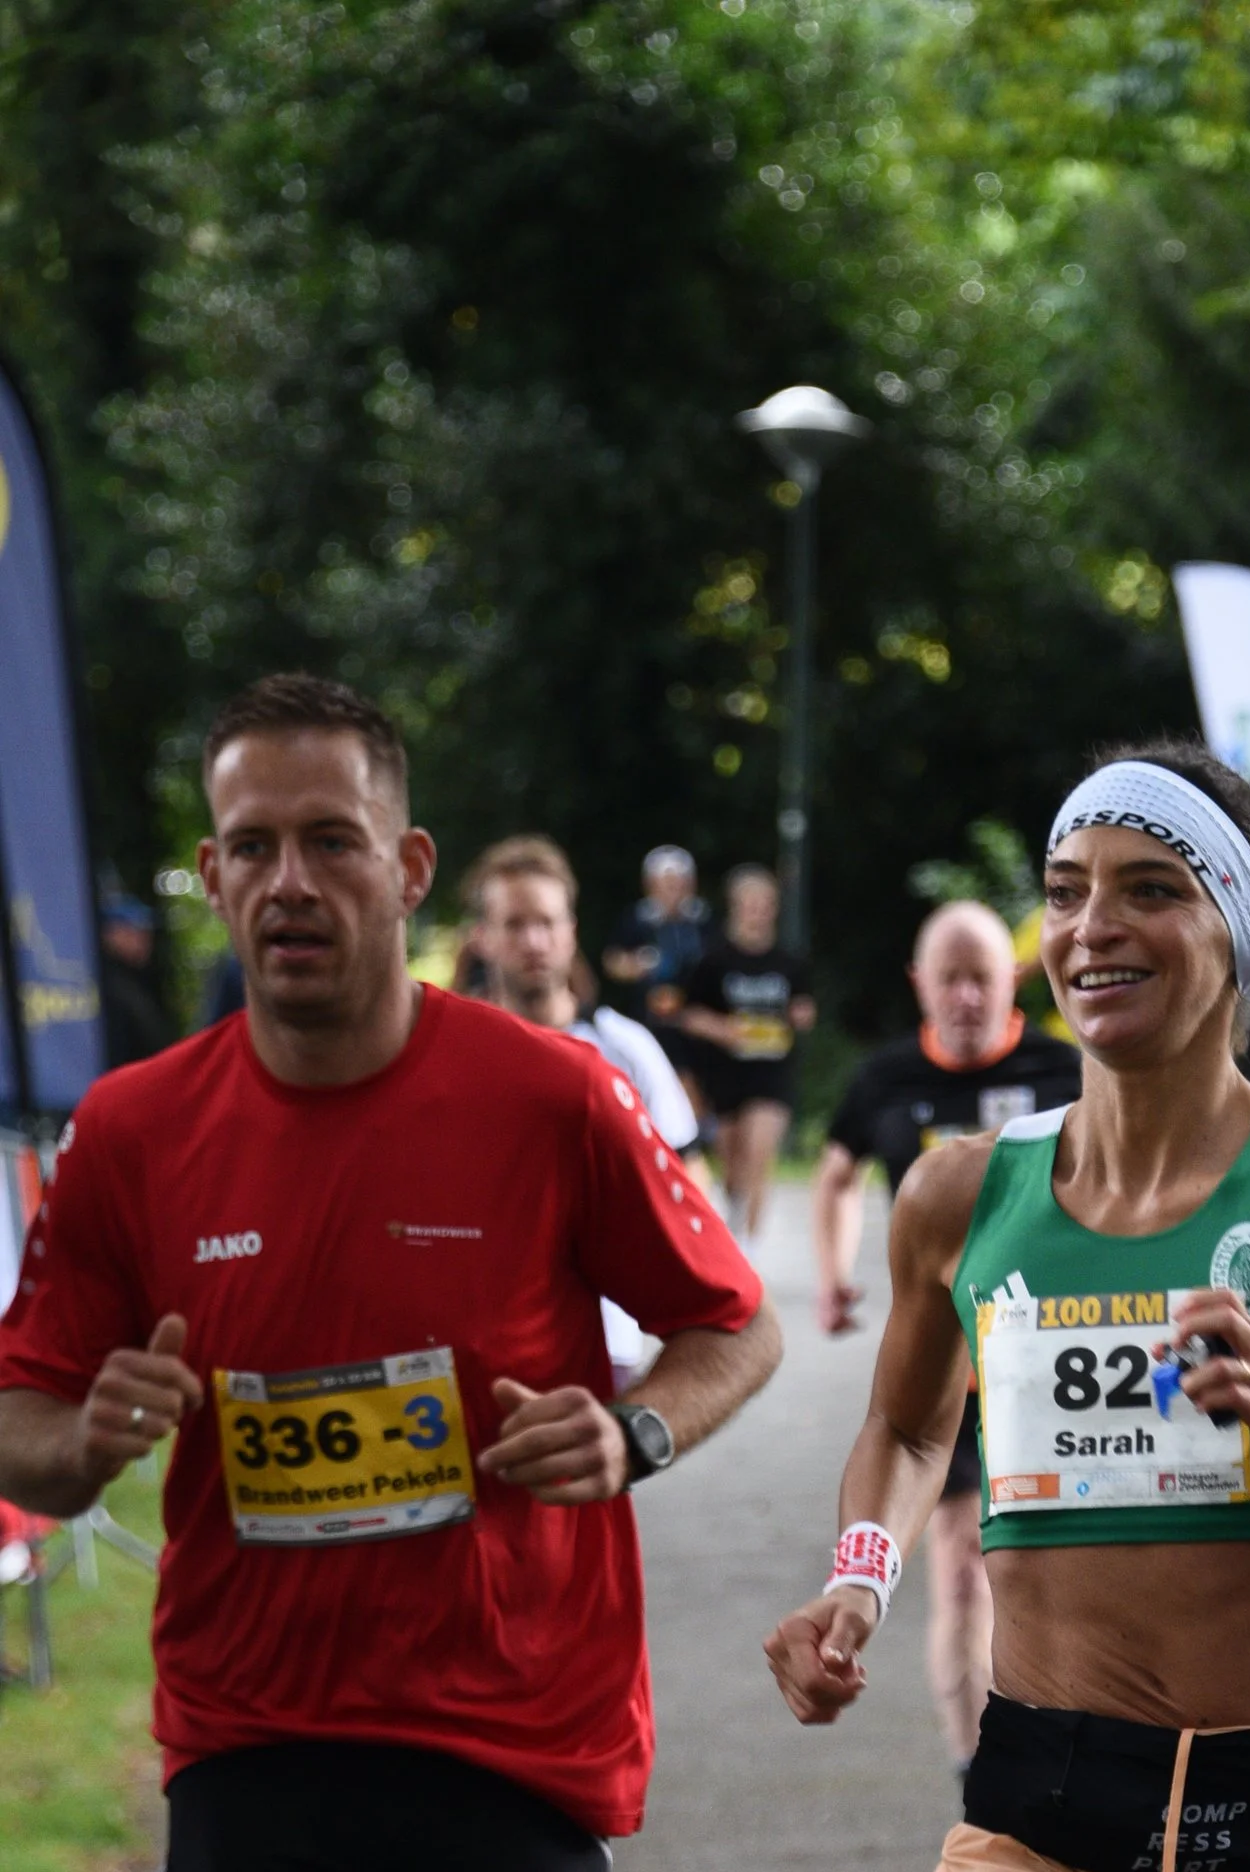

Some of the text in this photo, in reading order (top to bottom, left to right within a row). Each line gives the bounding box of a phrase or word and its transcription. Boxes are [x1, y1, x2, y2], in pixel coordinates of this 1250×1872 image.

[194, 1231, 262, 1262] JAKO
[1040, 1293, 1165, 1328] 100 KM
[1053, 1345, 1152, 1411] 82
[234, 1410, 362, 1470] 336
[1053, 1428, 1155, 1457] Sarah
[238, 1464, 462, 1506] Brandweer Pekela
